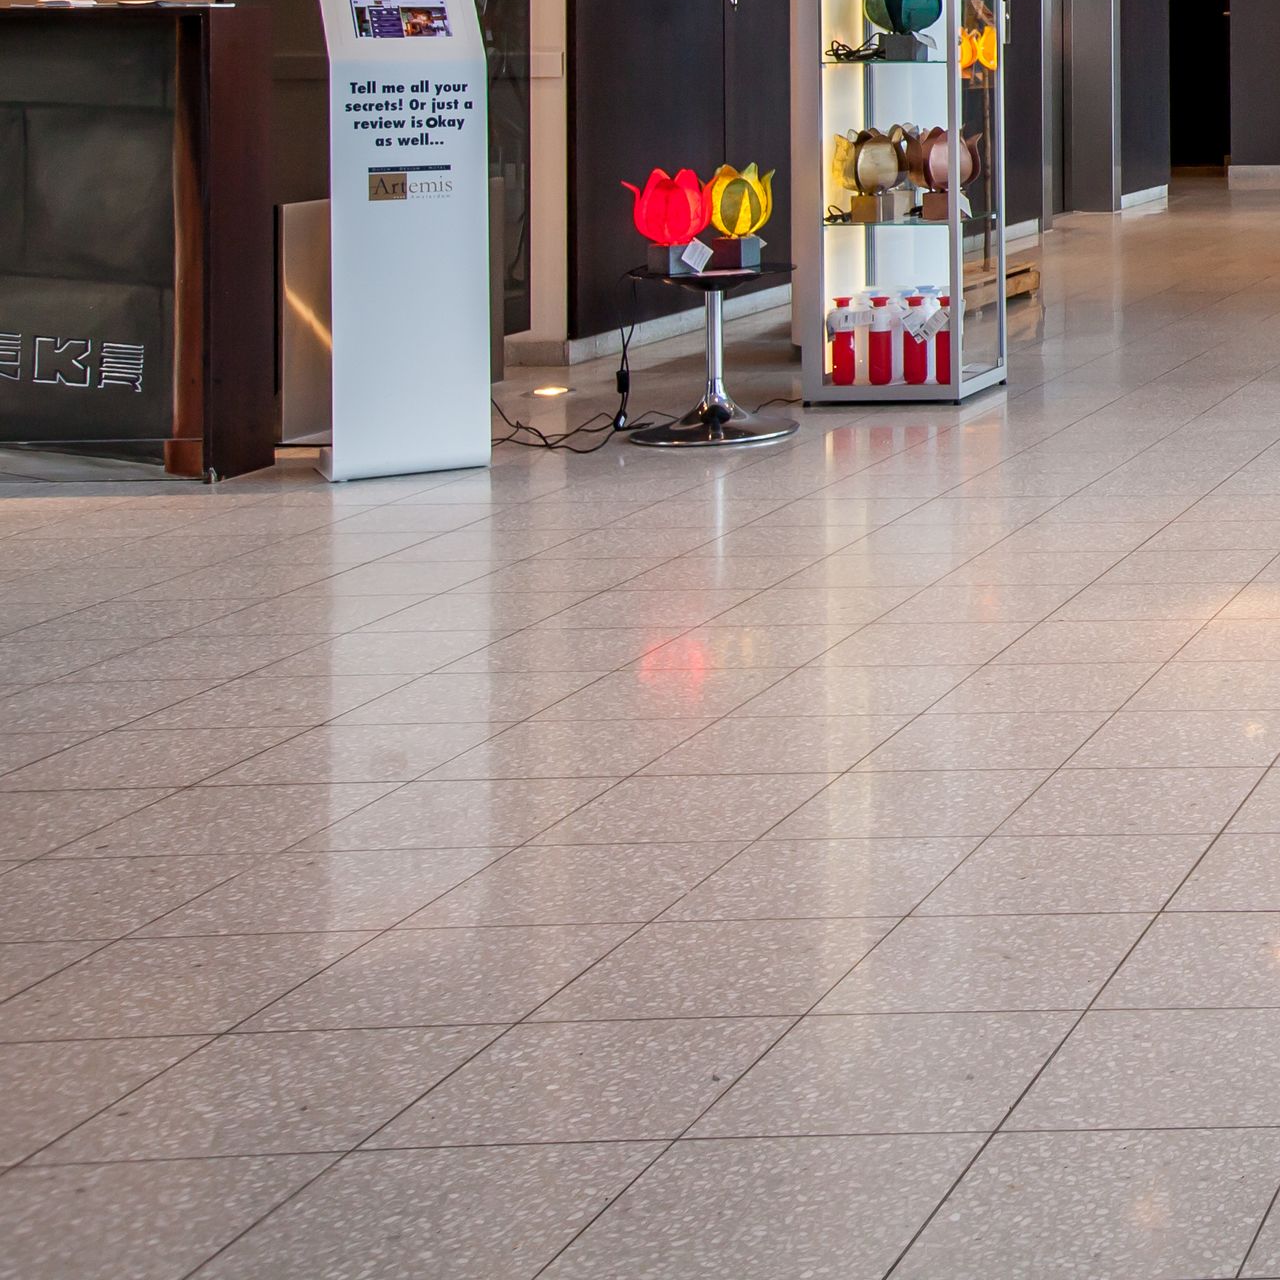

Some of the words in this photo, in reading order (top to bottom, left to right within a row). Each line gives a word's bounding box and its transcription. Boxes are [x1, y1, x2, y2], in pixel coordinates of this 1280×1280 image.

[350, 81, 377, 94] Tell
[382, 84, 405, 94] me
[410, 80, 430, 93] all
[434, 82, 468, 96] your
[345, 99, 403, 112] secrets!
[409, 99, 427, 111] Or
[431, 98, 459, 113] just
[464, 101, 473, 110] a
[353, 117, 405, 129] review
[411, 117, 424, 128] is
[425, 116, 464, 131] Okay
[375, 136, 393, 147] as
[397, 133, 445, 146] well...
[374, 175, 453, 195] Artemis
